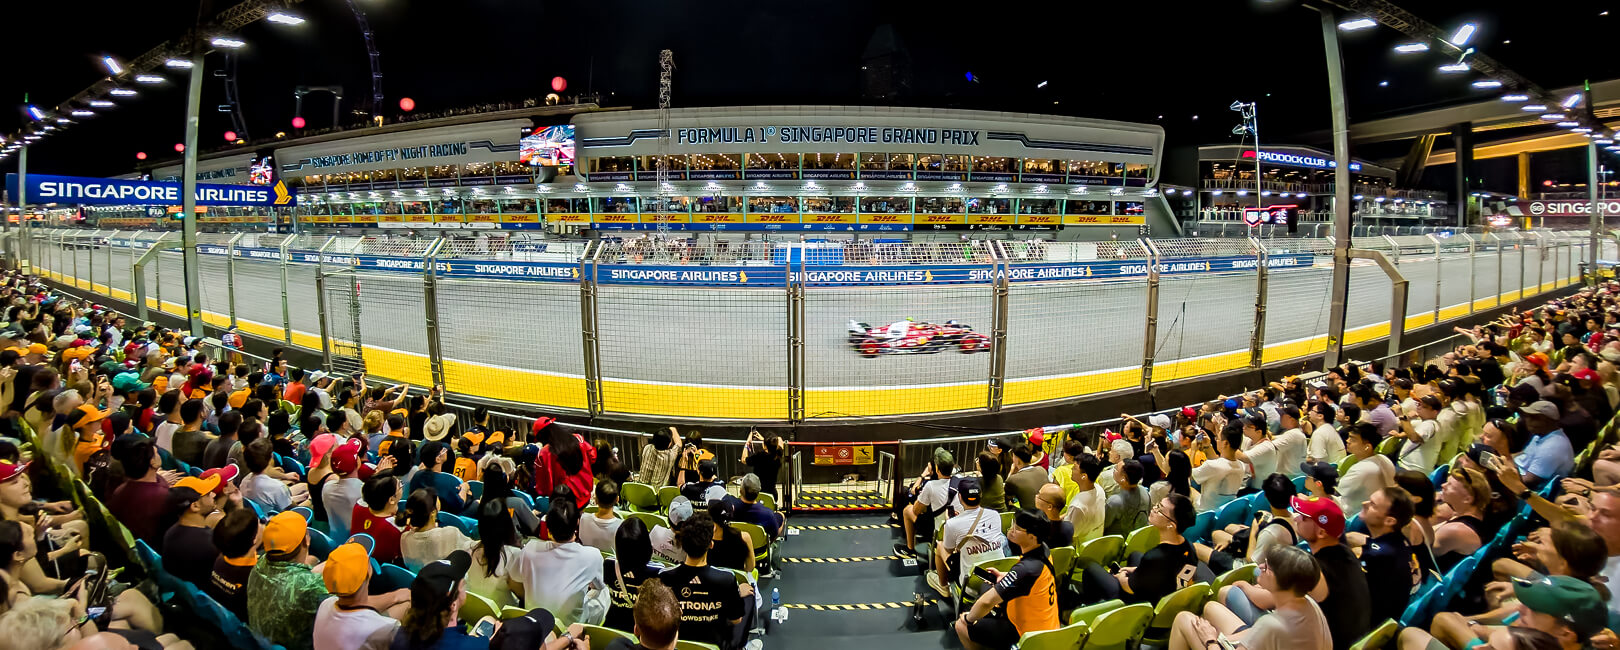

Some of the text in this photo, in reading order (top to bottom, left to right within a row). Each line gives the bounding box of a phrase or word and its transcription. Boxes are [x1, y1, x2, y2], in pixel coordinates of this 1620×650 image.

[678, 127, 755, 144] FORMULA
[780, 127, 876, 144] SINGAPORE
[882, 128, 937, 144] GRAND
[941, 129, 979, 146] PRIX
[354, 151, 373, 164] HOME
[374, 150, 385, 163] OF
[400, 144, 428, 160] NIGHT
[430, 142, 467, 158] RACING
[1258, 151, 1304, 163] PADDOCK
[1304, 157, 1326, 166] CLUB
[40, 181, 178, 201] SINGAPORE
[376, 260, 412, 269] SINGAPORE
[474, 264, 571, 277] SINGAPORE AIRLINES
[1170, 262, 1206, 272] AIRLINES
[611, 269, 738, 282] SINGAPORE AIRLINES
[864, 270, 923, 281] AIRLINES
[1038, 267, 1084, 278] AIRLINES
[678, 601, 722, 610] TRONAS
[681, 614, 718, 622] OWDSTRIKE
